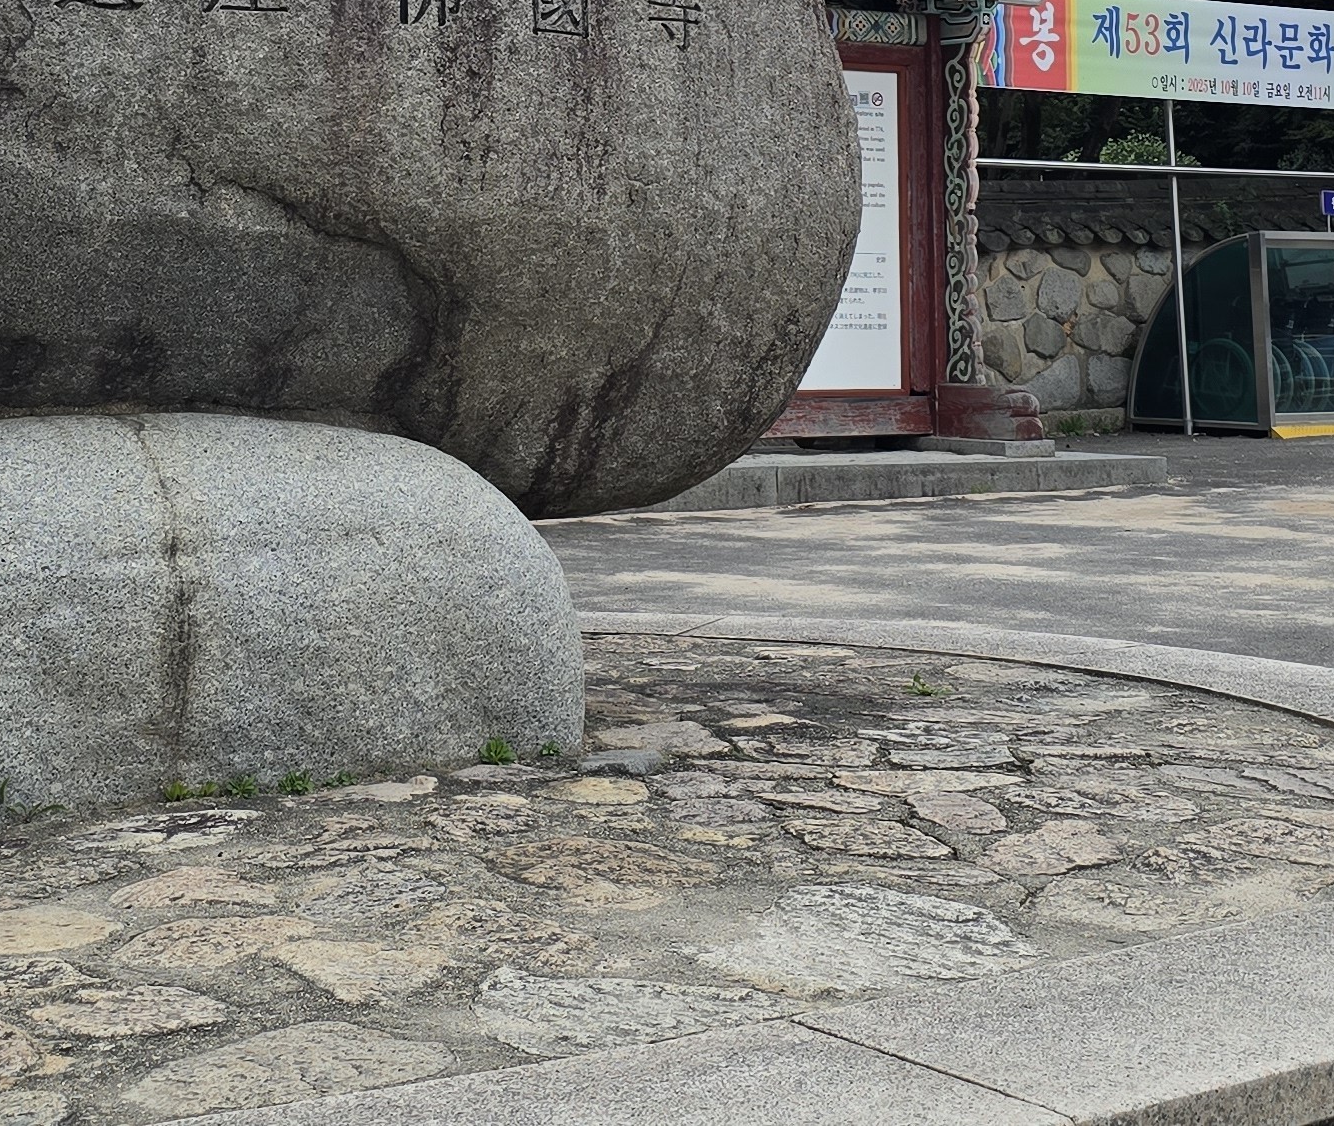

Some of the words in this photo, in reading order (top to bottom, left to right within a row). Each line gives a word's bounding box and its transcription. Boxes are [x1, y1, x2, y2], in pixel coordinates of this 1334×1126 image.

[1019, 1, 1060, 72] 봉
[1091, 5, 1190, 64] 제53회
[1187, 77, 1217, 95] 2025년
[1220, 79, 1239, 97] 10월
[1242, 80, 1260, 98] 10일
[1265, 82, 1291, 100] 금요일
[1296, 84, 1331, 102] 오전11시
